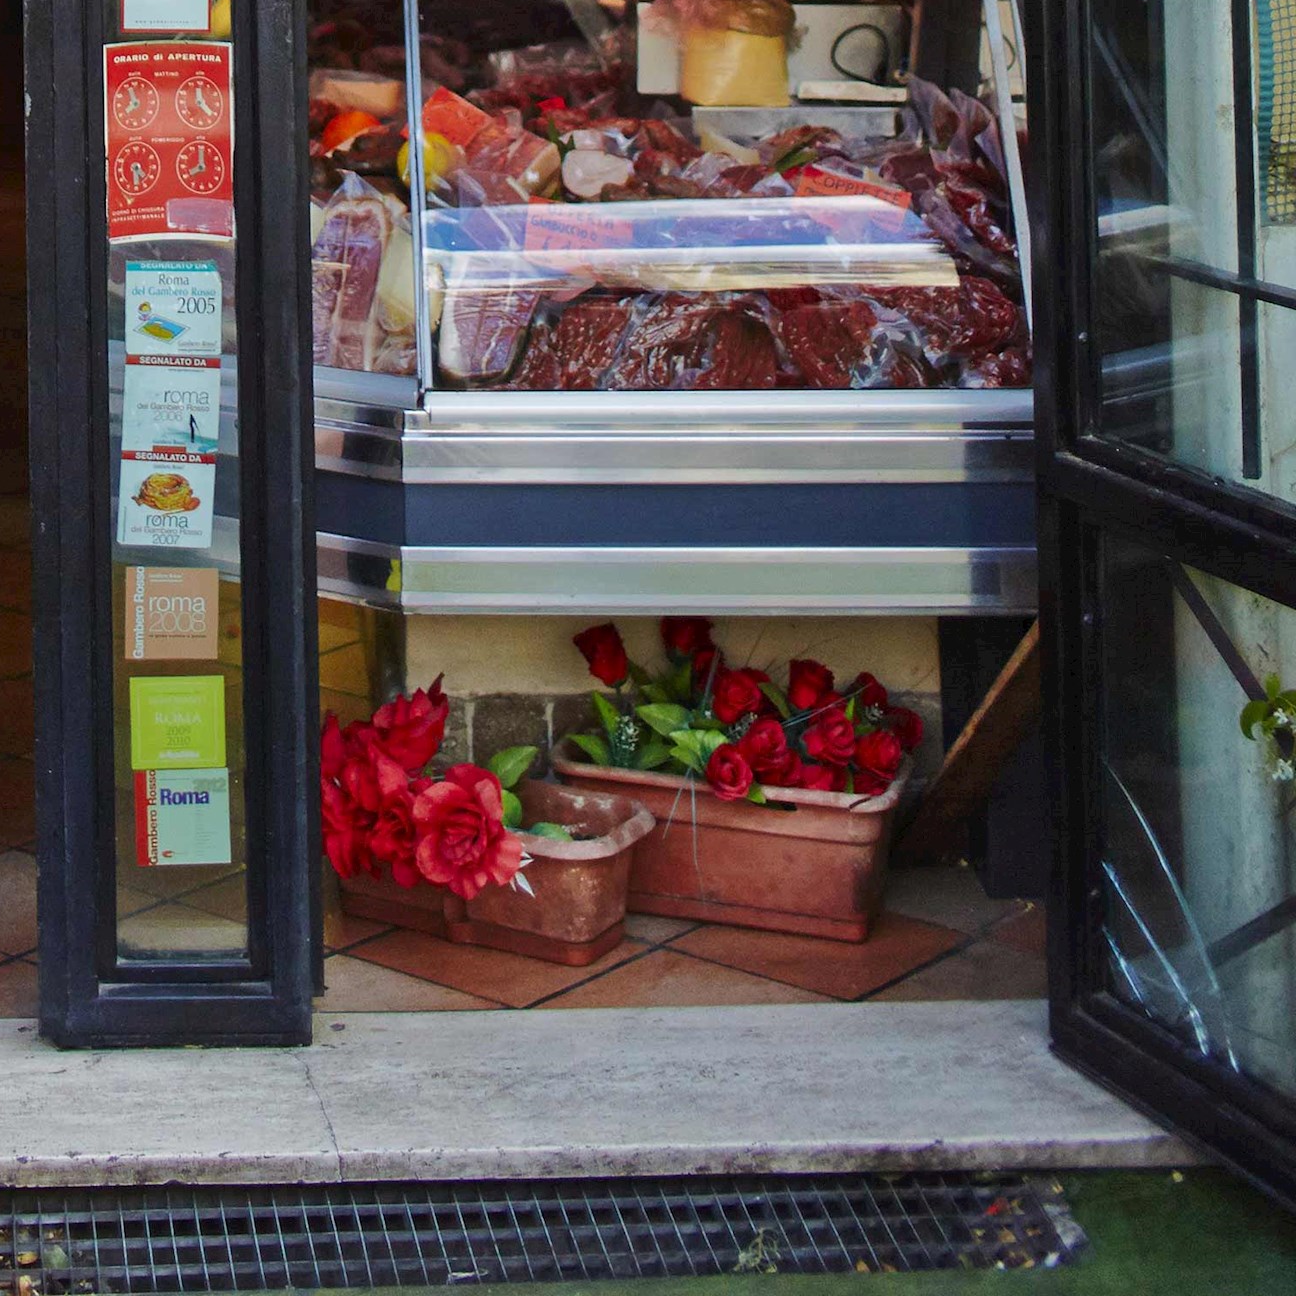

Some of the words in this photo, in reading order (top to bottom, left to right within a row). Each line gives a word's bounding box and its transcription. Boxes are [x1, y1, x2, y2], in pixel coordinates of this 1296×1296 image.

[113, 53, 149, 64] ORARIO
[168, 53, 222, 63] APERTURA
[158, 274, 189, 286] Roma
[132, 286, 145, 296] del
[148, 286, 189, 296] Gambero
[177, 297, 215, 314] 2005
[139, 356, 192, 365] SEGNALATO
[164, 390, 209, 405] roma
[153, 410, 183, 421] 2006
[135, 452, 187, 462] SEGNALATO
[188, 454, 202, 462] DA
[146, 514, 188, 528] roma
[152, 534, 180, 545] 2007
[133, 566, 144, 603] Rosso
[148, 596, 206, 613] roma
[148, 611, 206, 633] 2008
[132, 605, 144, 659] Gambero
[147, 770, 157, 806] Rosso
[160, 788, 210, 806] Roma
[147, 810, 158, 865] Gambero
